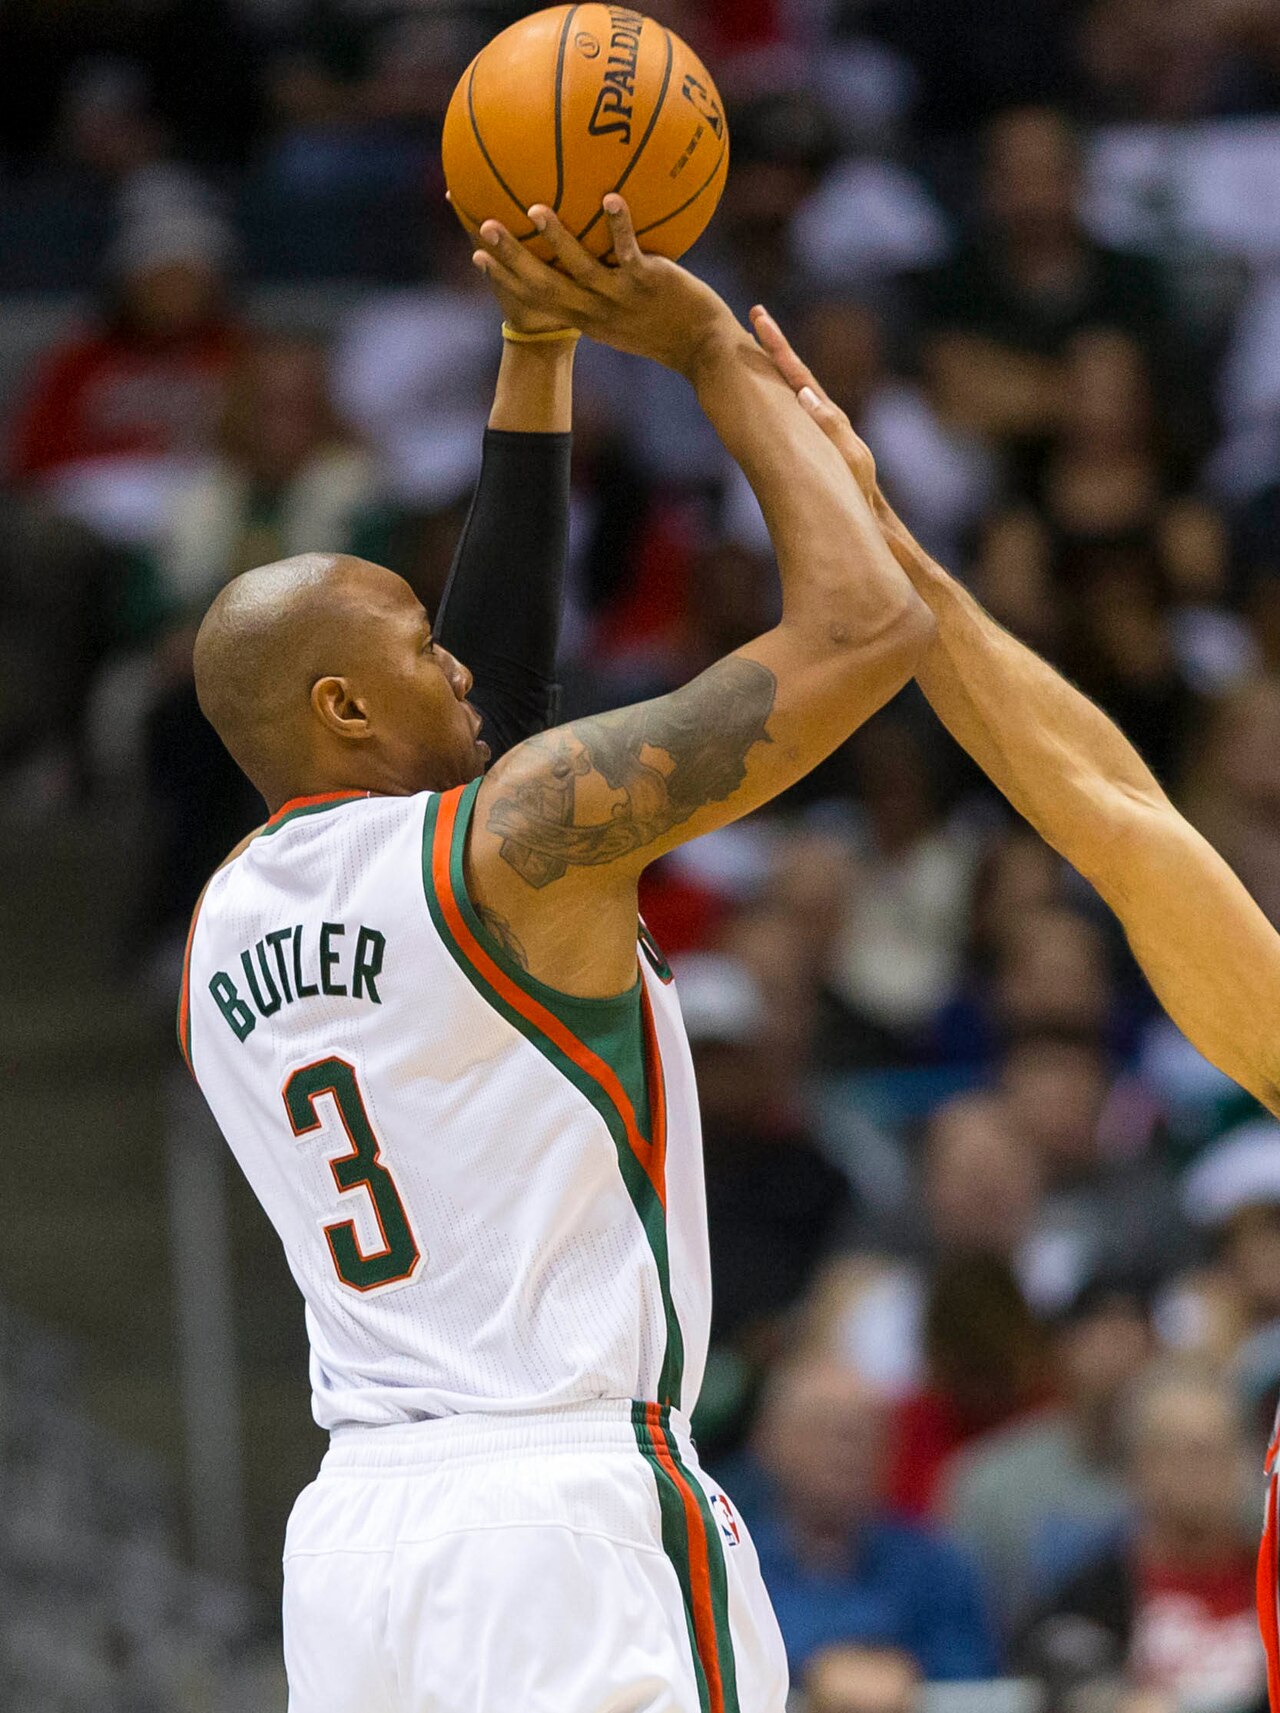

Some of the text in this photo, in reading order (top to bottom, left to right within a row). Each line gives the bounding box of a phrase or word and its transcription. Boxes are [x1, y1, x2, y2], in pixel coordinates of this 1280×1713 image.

[588, 5, 643, 145] SPALDIN
[208, 921, 386, 1043] BUTLER
[281, 1054, 421, 1293] 3
